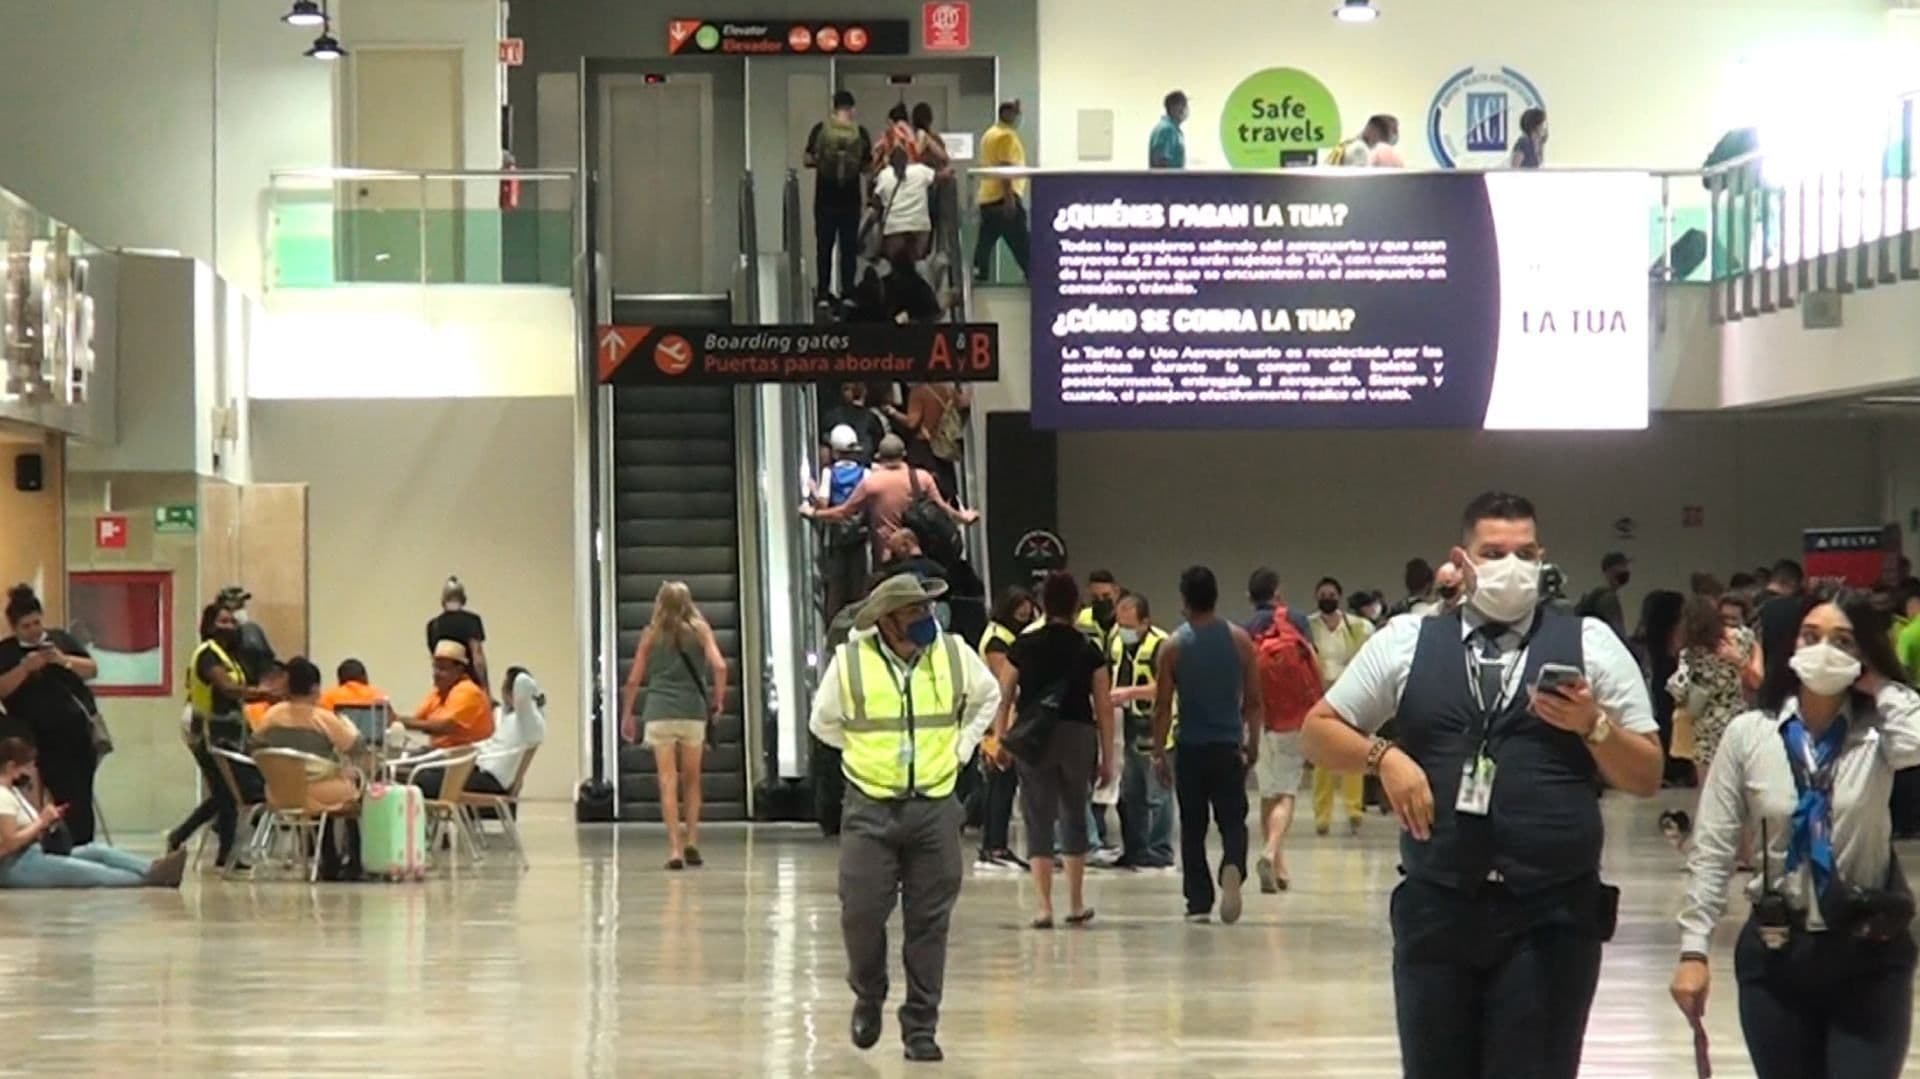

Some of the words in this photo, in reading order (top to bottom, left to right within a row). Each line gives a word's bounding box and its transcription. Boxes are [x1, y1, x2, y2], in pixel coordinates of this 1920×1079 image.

[723, 24, 768, 36] Elevator
[723, 38, 783, 52] Elevador
[1251, 95, 1306, 119] Safe
[1469, 95, 1505, 144] ACI
[1238, 118, 1325, 143] travels
[1053, 198, 1165, 231] ¿QUIÉNES
[1169, 204, 1249, 229] PAGAN
[1253, 204, 1284, 228] LA
[1287, 203, 1349, 228] TUA?
[1104, 239, 1126, 252] los
[1128, 239, 1196, 254] pasajeros
[1260, 239, 1284, 251] del
[1286, 240, 1366, 254] aeropuerto
[1368, 241, 1379, 253] y
[1380, 241, 1410, 254] que
[1121, 253, 1140, 266] de
[1285, 253, 1304, 266] de
[1306, 252, 1343, 267] TUA,
[1344, 255, 1372, 266] con
[1058, 267, 1078, 281] de
[1080, 266, 1102, 281] los
[1103, 268, 1171, 283] pasajeros
[1173, 269, 1201, 283] que
[1306, 268, 1326, 280] en
[1327, 267, 1343, 280] el
[1344, 268, 1425, 282] aeropuerto
[1426, 268, 1447, 280] en
[1125, 284, 1137, 295] o
[1052, 303, 1137, 337] ¿CÓMO
[1140, 308, 1171, 332] SE
[1172, 308, 1258, 333] COBRA
[1261, 309, 1292, 332] LA
[1295, 308, 1356, 332] TUA?
[1522, 310, 1556, 333] LA
[1571, 310, 1627, 333] TUA
[705, 332, 791, 354] Boarding
[797, 335, 850, 354] gates
[928, 333, 952, 370] A
[970, 332, 991, 370] B
[1061, 346, 1080, 359] La
[1083, 346, 1123, 359] Tarifa
[1126, 347, 1146, 359] de
[1150, 346, 1178, 359] Uso
[1392, 347, 1420, 360] por
[1422, 344, 1444, 358] las
[704, 354, 779, 373] Puertas
[784, 357, 830, 376] para
[834, 353, 914, 371] abordar
[1151, 360, 1208, 373] durante
[1256, 362, 1311, 375] compra
[1328, 360, 1352, 373] del
[1369, 360, 1418, 373] boleto
[1433, 361, 1445, 374] y
[1368, 374, 1428, 388] Siempre
[1433, 376, 1445, 389] y
[1119, 389, 1135, 402] el
[1136, 389, 1197, 403] pasajero
[1351, 387, 1367, 400] el
[1831, 536, 1877, 547] DELTA
